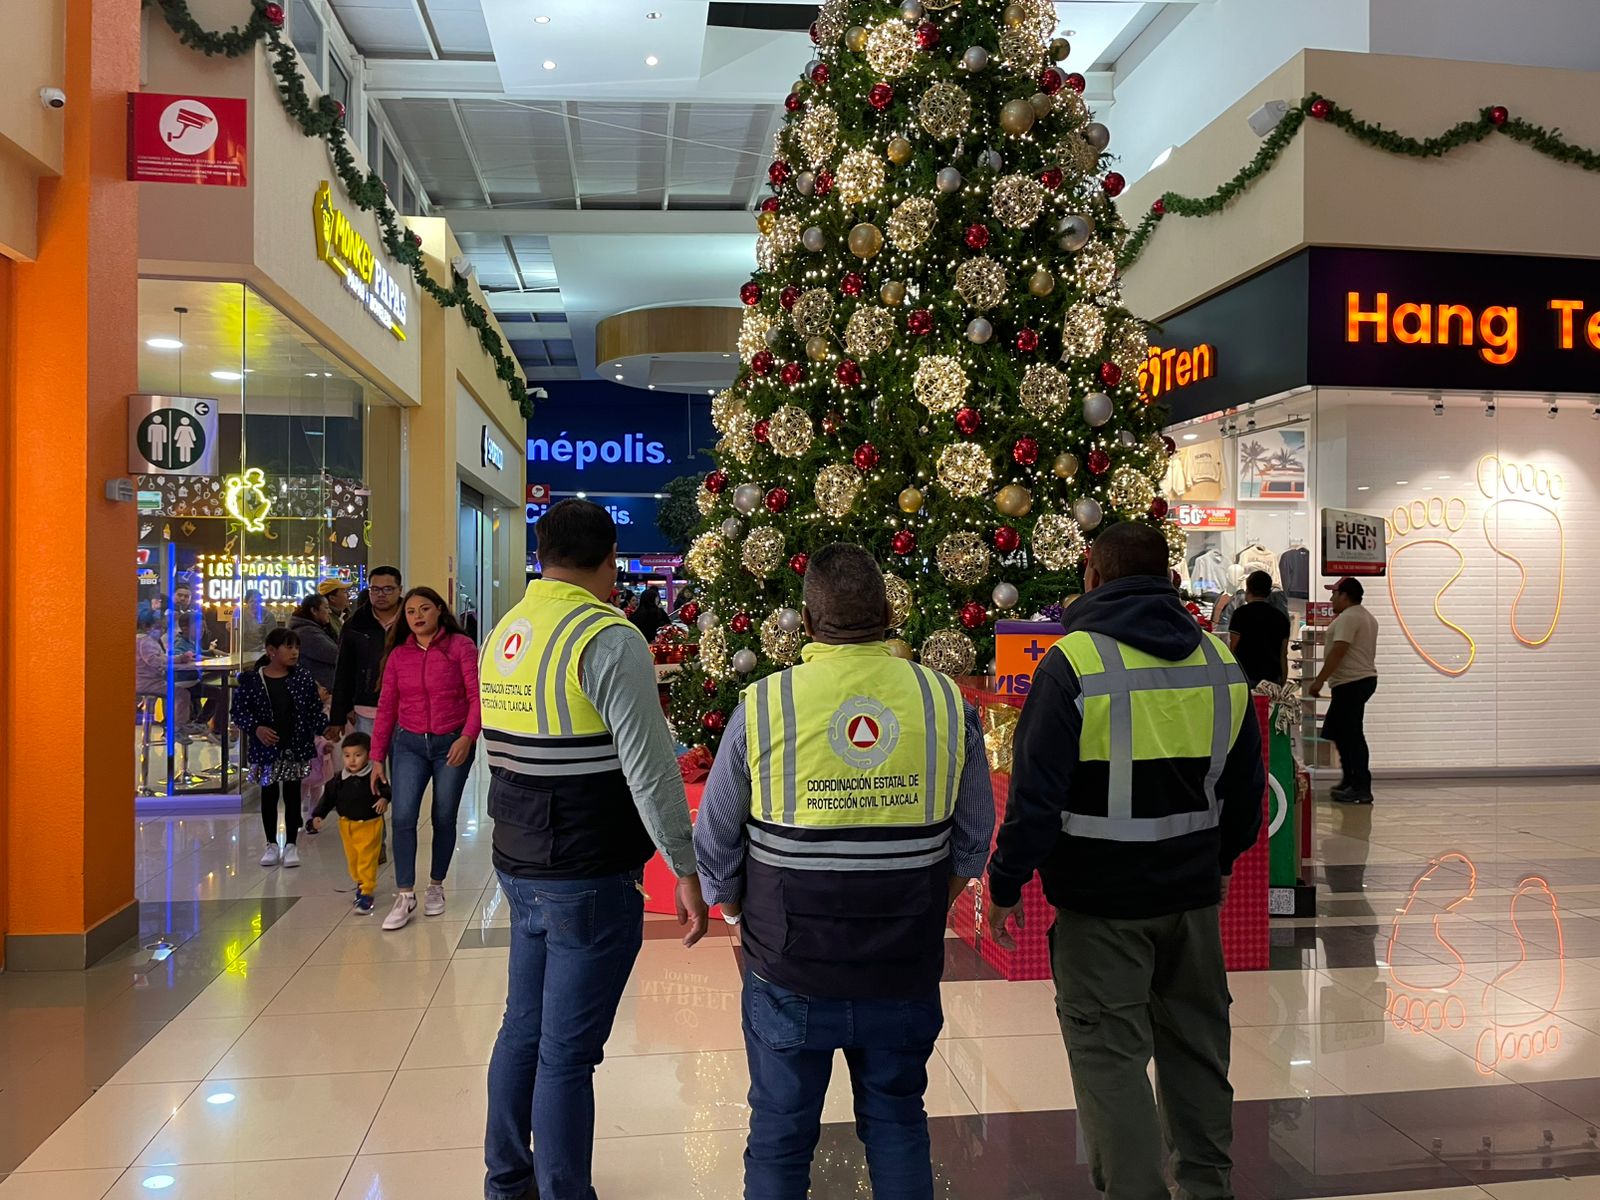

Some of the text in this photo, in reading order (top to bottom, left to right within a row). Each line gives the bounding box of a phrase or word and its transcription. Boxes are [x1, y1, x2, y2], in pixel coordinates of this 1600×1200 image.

[334, 210, 374, 284] MONKEY
[374, 258, 407, 326] PAPAS
[1346, 291, 1518, 365] Hang
[1161, 343, 1211, 392] Ten
[1335, 520, 1377, 538] BUEN
[208, 560, 316, 577] LAS PAPAS MÁS
[524, 684, 532, 696] DE
[807, 774, 919, 792] COORDINACIÓN ESTATAL DE
[807, 793, 919, 810] PROTECCIÓN CIVIL TLAXCALA
